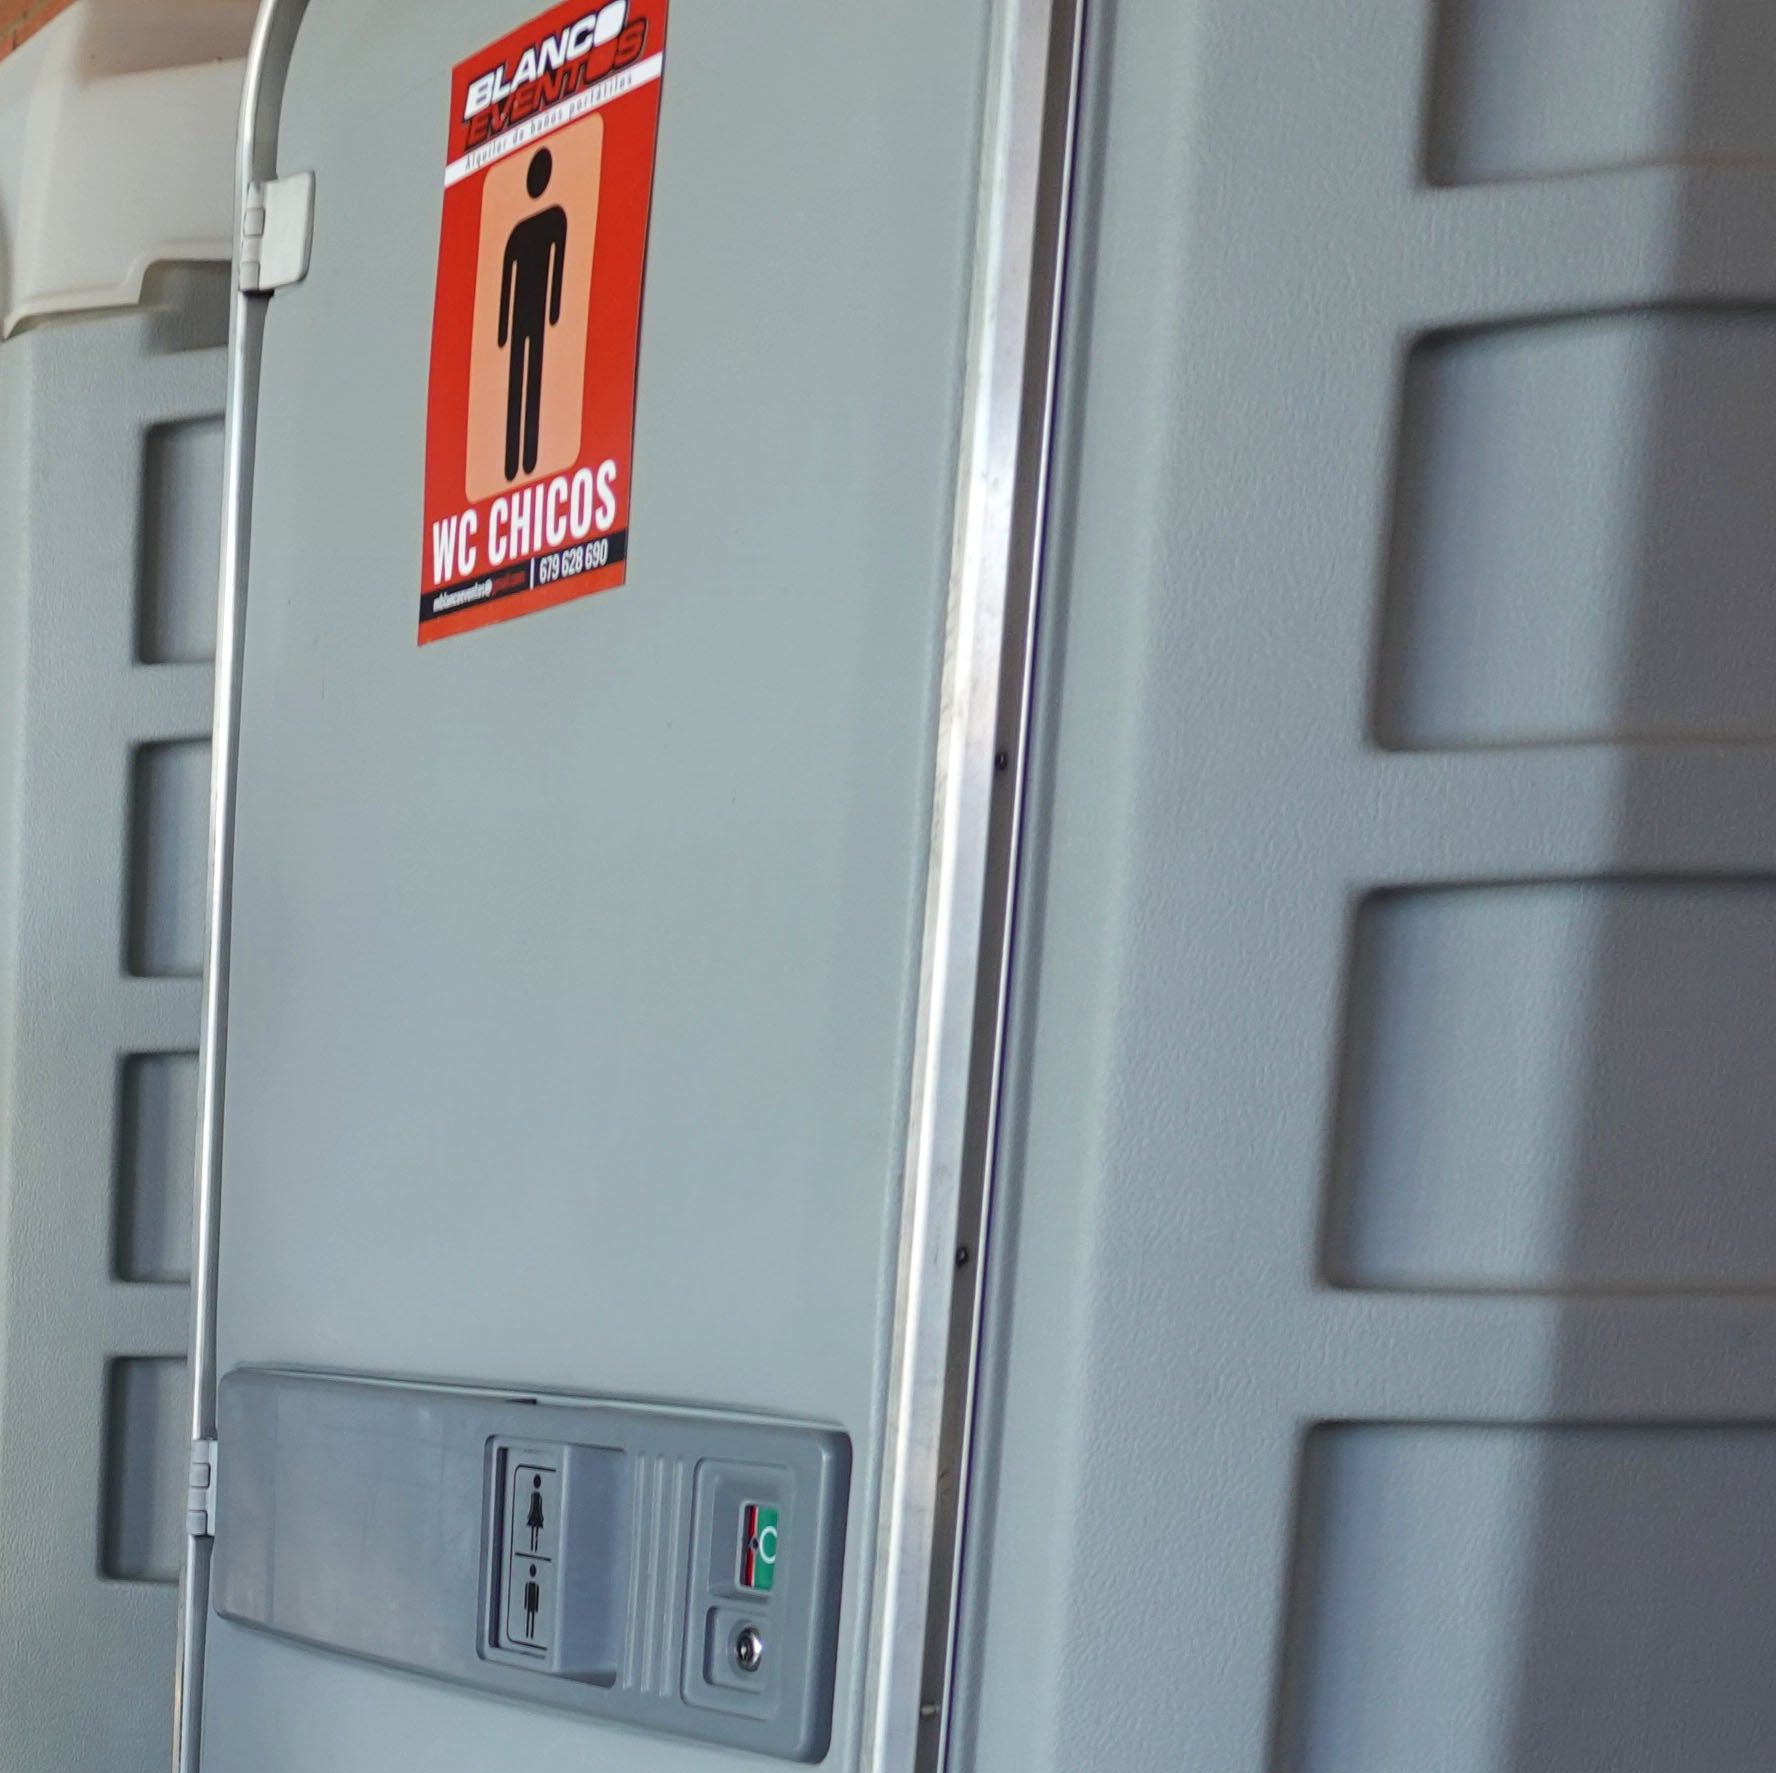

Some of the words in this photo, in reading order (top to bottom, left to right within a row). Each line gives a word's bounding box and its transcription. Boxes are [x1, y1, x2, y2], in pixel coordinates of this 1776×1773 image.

[463, 0, 628, 122] BLANCO
[465, 18, 647, 151] EVENTOS
[432, 508, 478, 586] WC
[488, 458, 617, 567] CHICOS
[539, 554, 560, 585] 679
[561, 546, 583, 577] 628
[584, 538, 608, 570] 690
